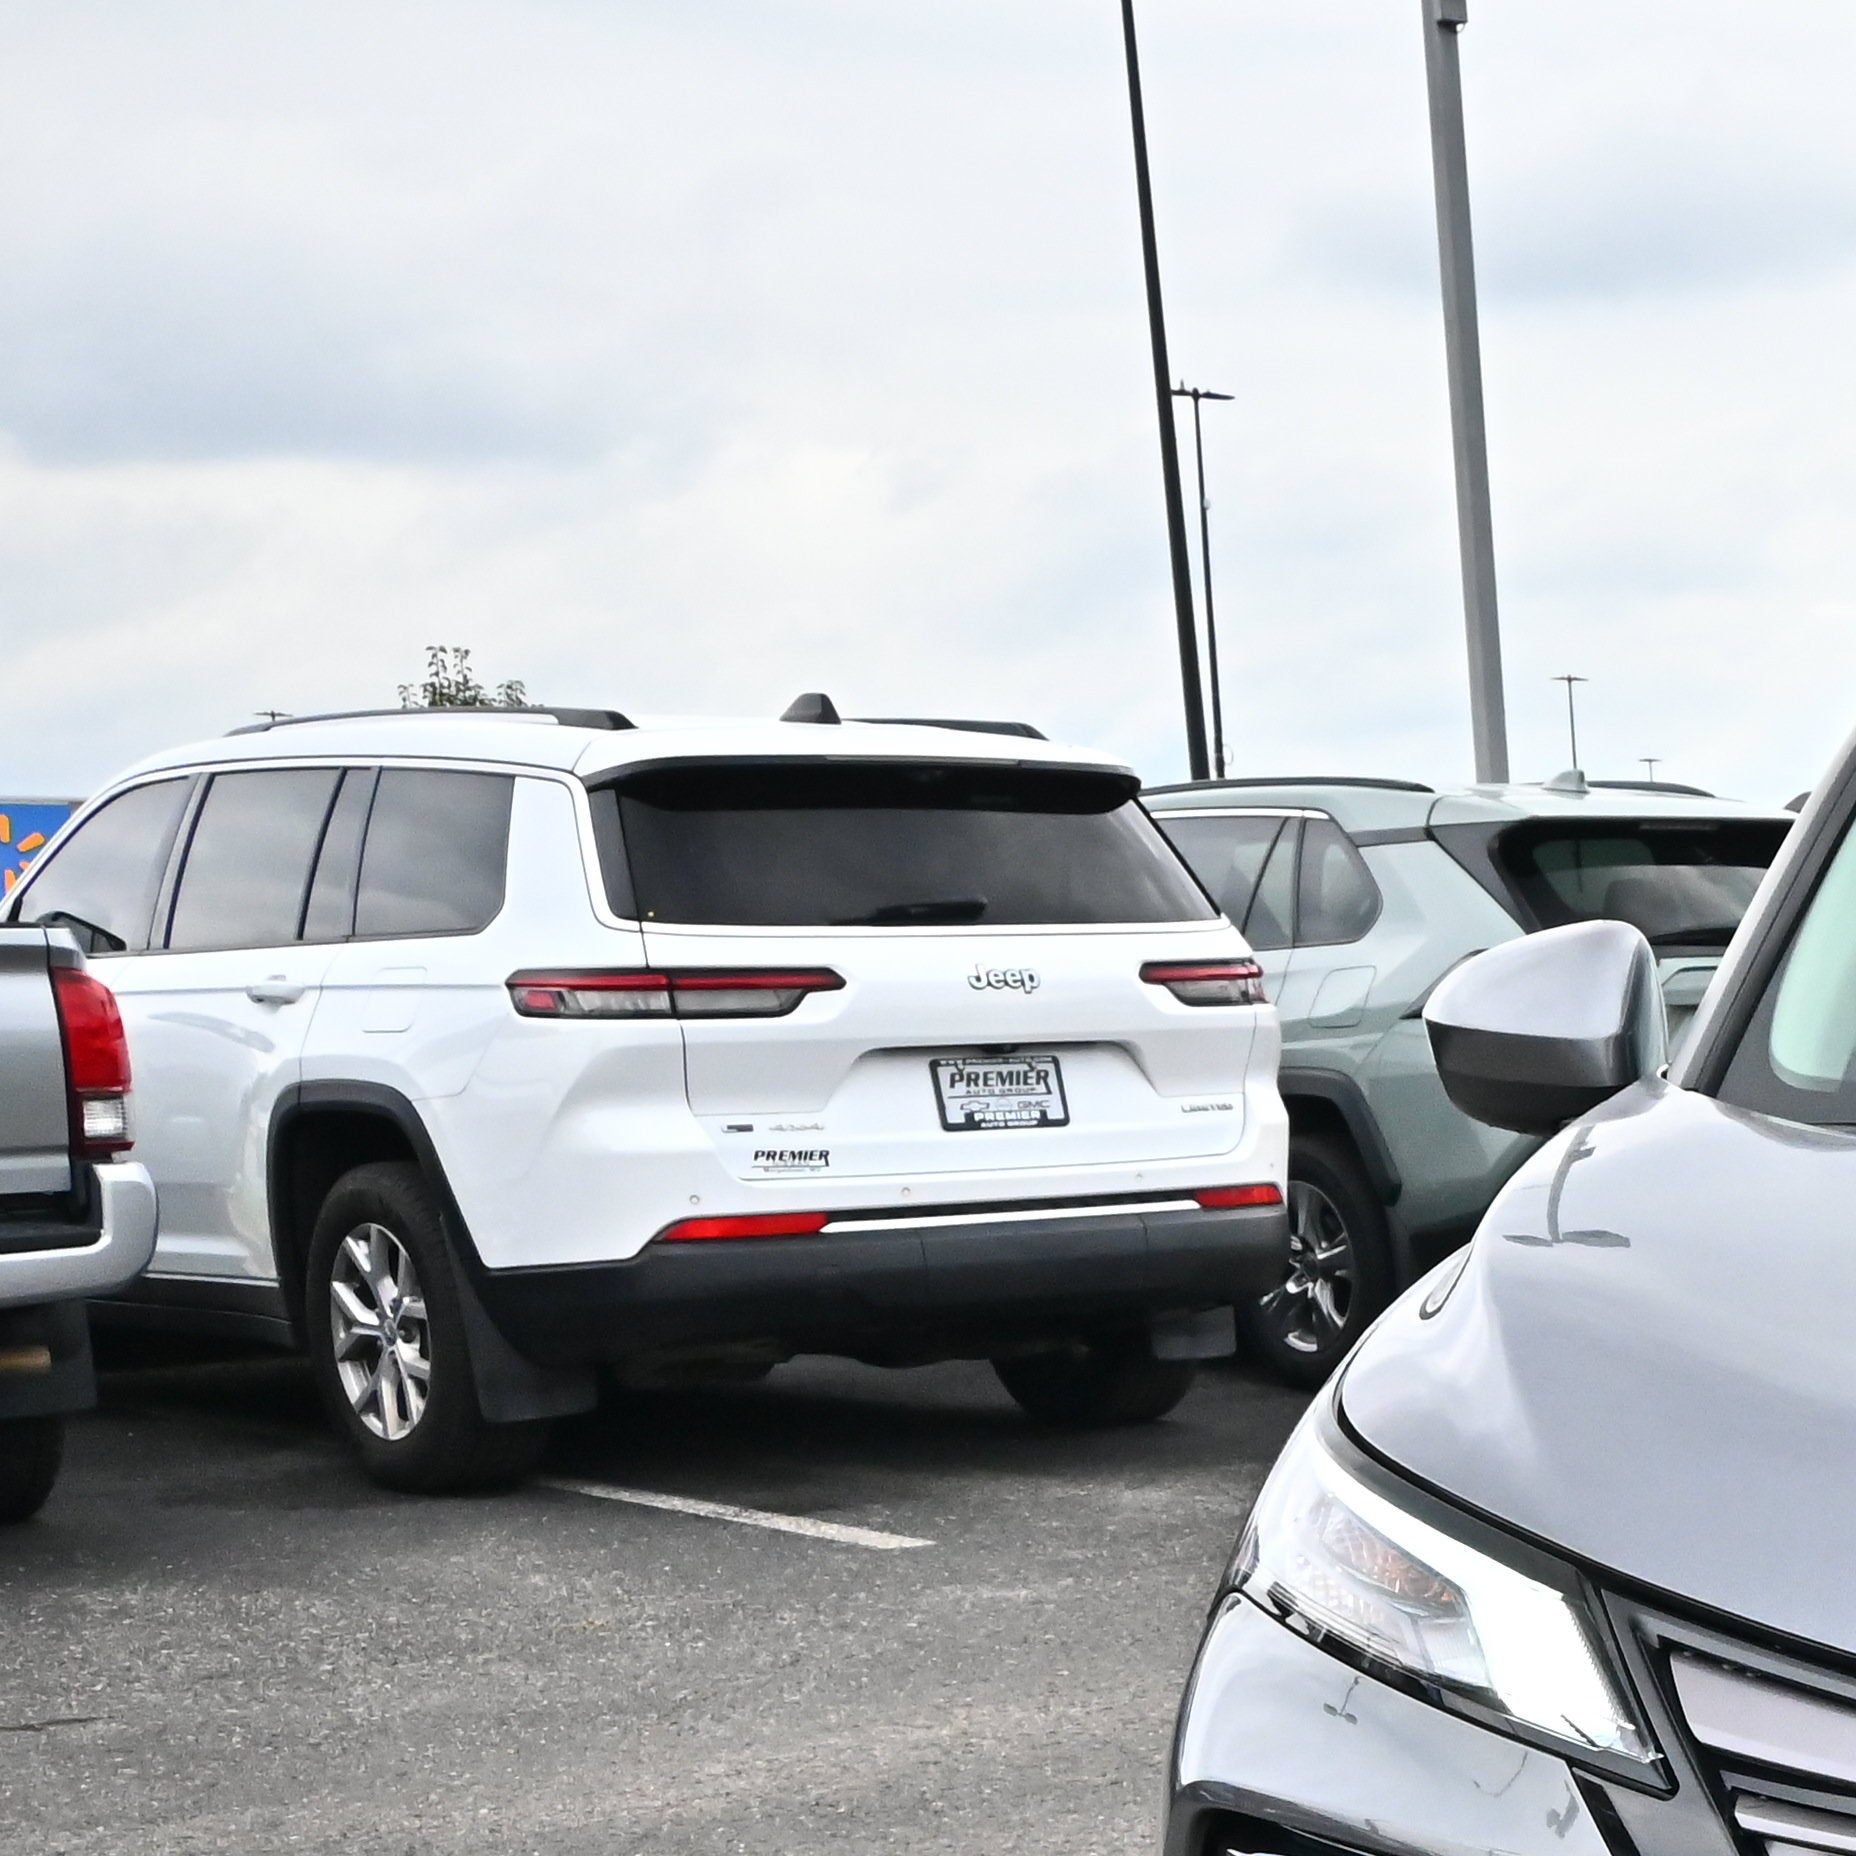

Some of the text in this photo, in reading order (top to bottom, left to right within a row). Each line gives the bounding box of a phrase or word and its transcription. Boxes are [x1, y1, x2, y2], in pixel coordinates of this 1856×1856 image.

[968, 963, 1041, 994] Jeep
[949, 1069, 1053, 1095] PREMIER
[1017, 1099, 1051, 1109] GMC
[973, 1110, 1041, 1122] PREMIER
[753, 1149, 830, 1167] PREMIER
